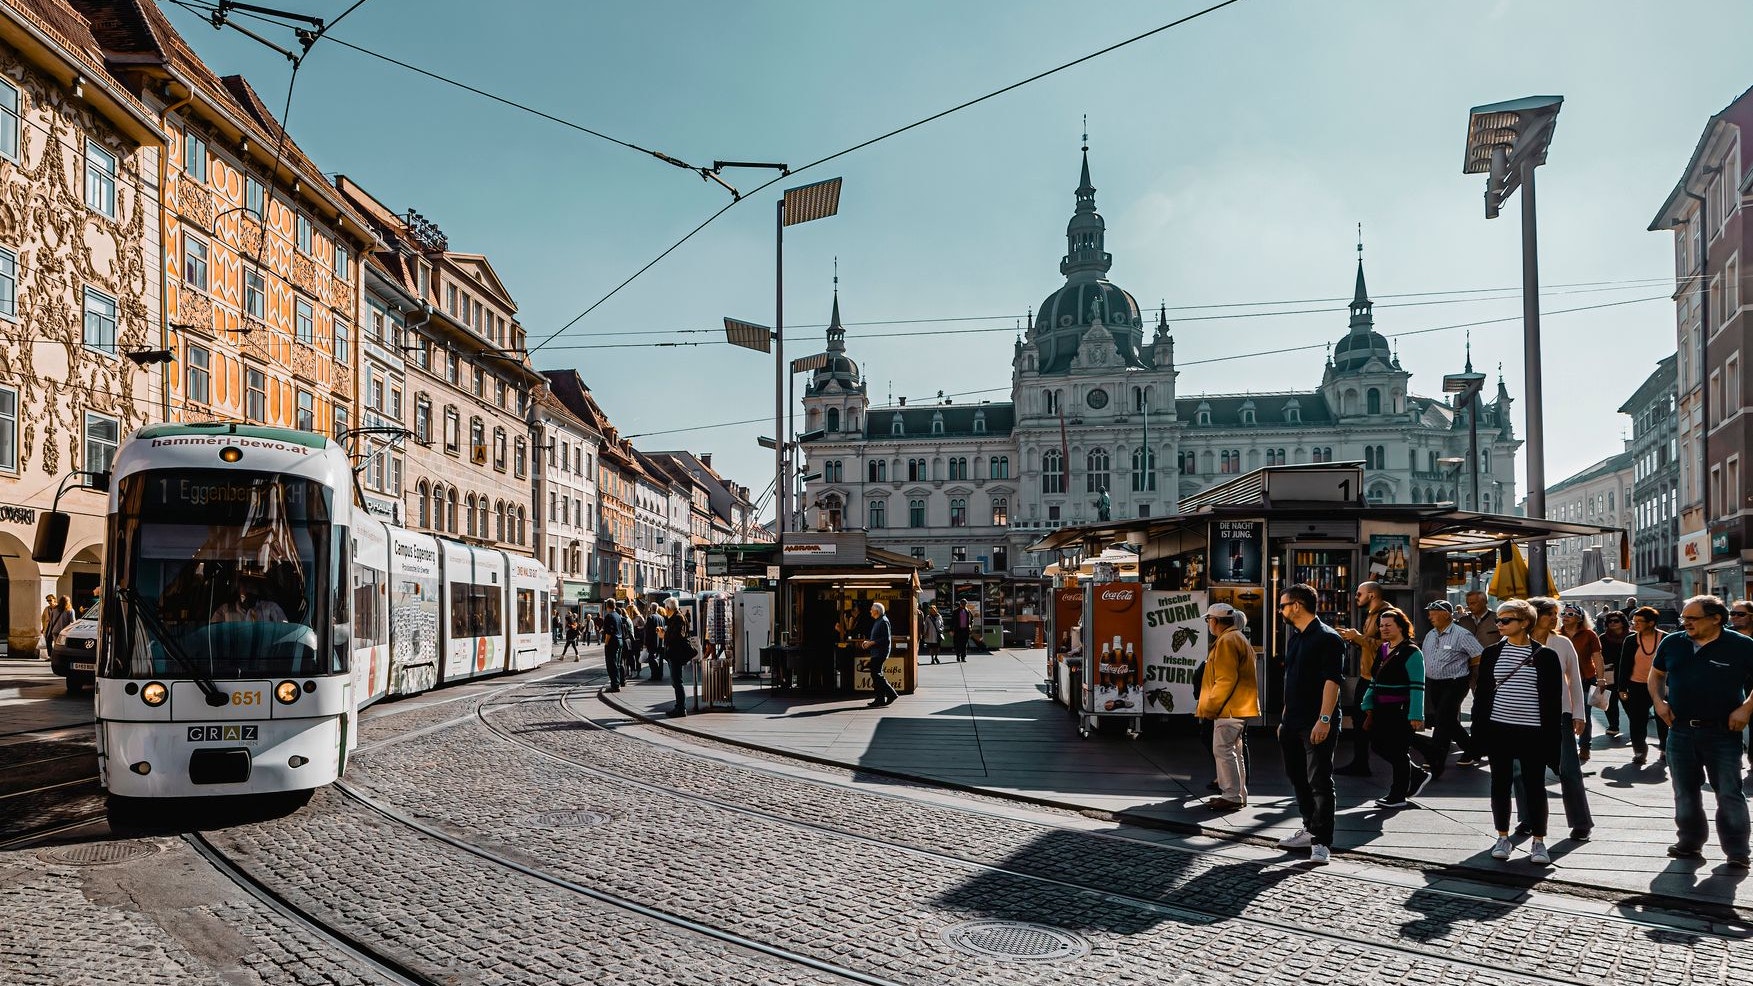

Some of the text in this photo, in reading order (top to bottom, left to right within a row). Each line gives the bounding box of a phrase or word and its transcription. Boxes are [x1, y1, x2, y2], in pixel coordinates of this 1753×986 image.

[152, 437, 309, 456] hammerl-bewo.at
[159, 479, 167, 504] 1
[1338, 479, 1350, 501] 1
[1220, 522, 1254, 530] DIE NACHT
[1221, 530, 1252, 538] IST JUNG.
[395, 539, 413, 559] Campus
[413, 543, 436, 565] Eggenberg
[1028, 569, 1038, 577] 14
[1158, 594, 1192, 607] frischer
[1146, 602, 1201, 628] STURM
[1163, 655, 1197, 667] frischer
[231, 690, 262, 706] 651
[189, 726, 256, 741] GRAZ
